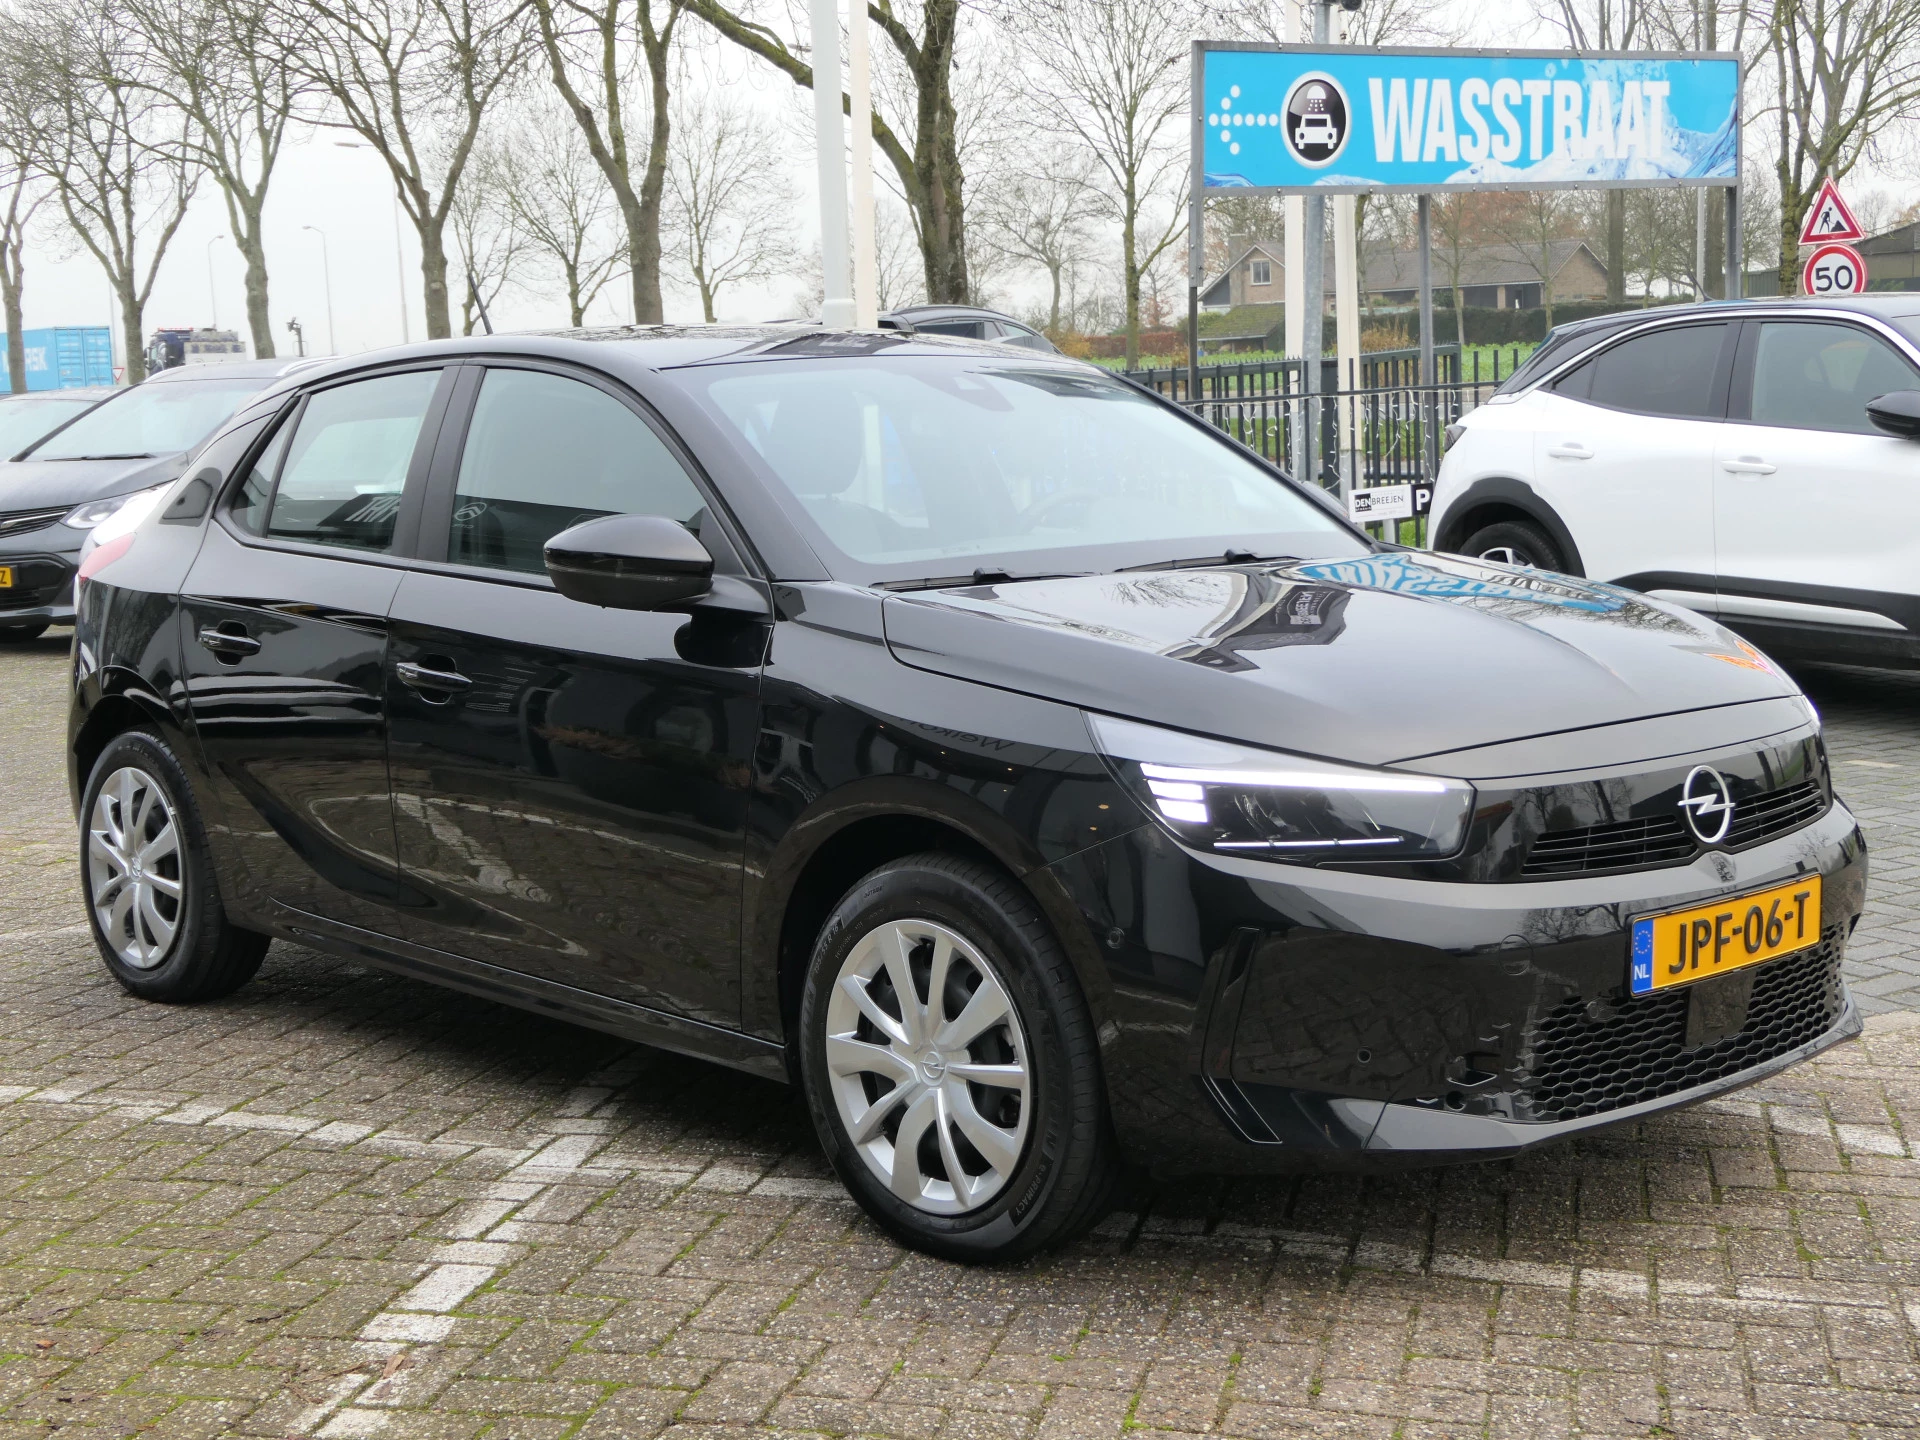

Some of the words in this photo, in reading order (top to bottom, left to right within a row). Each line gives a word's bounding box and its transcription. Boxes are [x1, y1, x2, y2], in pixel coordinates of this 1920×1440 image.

[1368, 77, 1670, 163] WASSTRAAT
[1815, 265, 1853, 292] 50
[1355, 497, 1371, 508] DEN
[1415, 489, 1430, 511] P
[1669, 891, 1810, 974] JPF-06-T
[1634, 964, 1649, 979] NL
